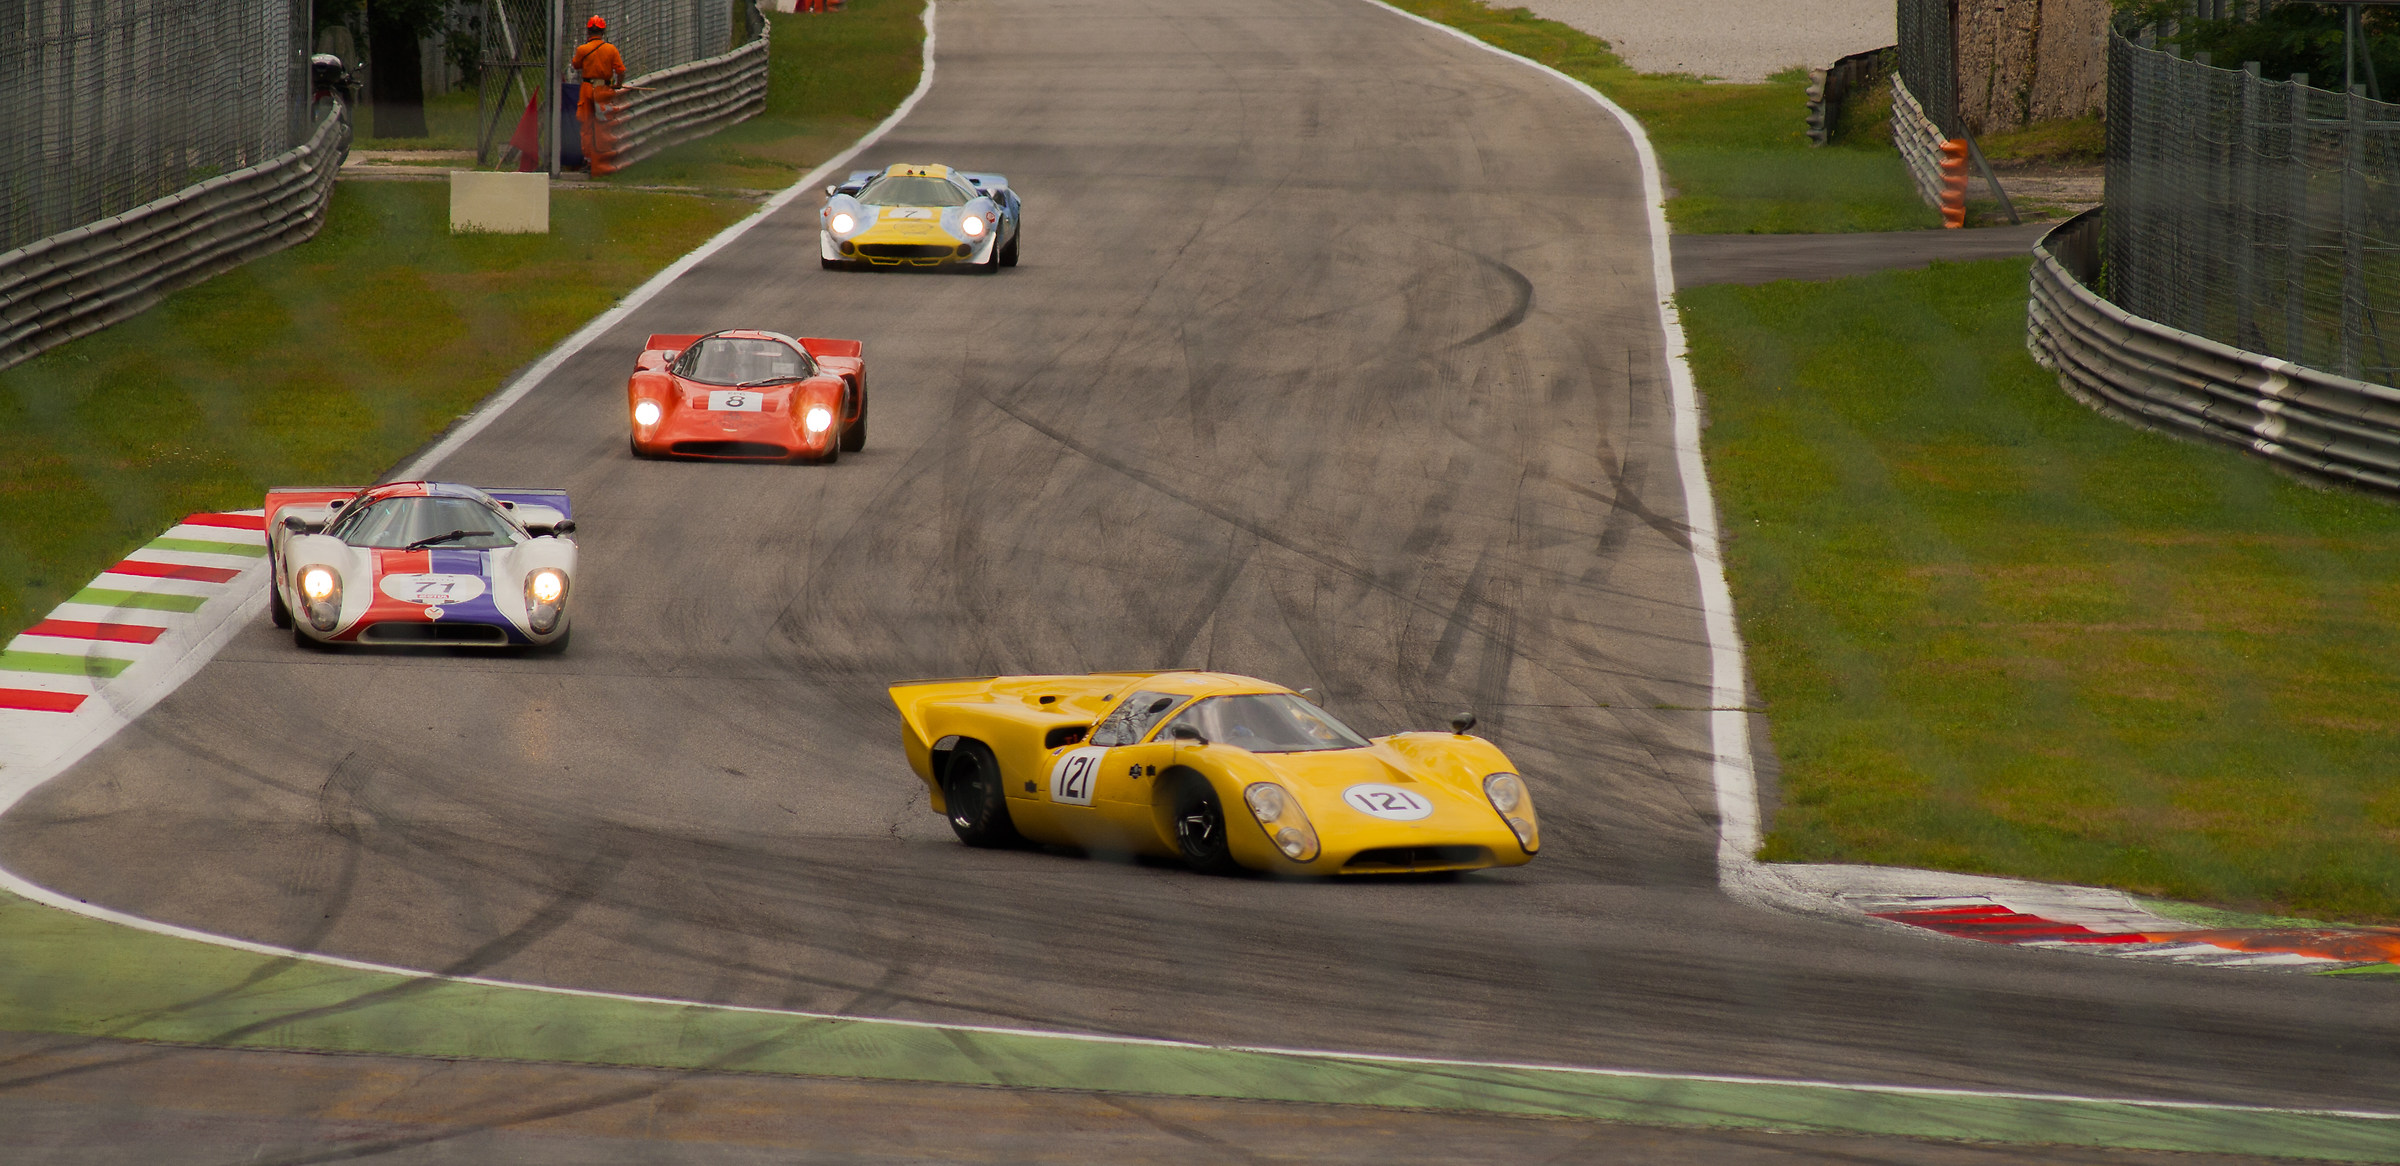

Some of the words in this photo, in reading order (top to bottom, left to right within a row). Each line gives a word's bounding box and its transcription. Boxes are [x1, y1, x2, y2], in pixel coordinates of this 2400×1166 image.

[905, 210, 918, 218] 7
[725, 395, 745, 407] 8
[415, 582, 455, 593] 71
[1059, 756, 1096, 799] 121
[1354, 792, 1421, 811] 121
